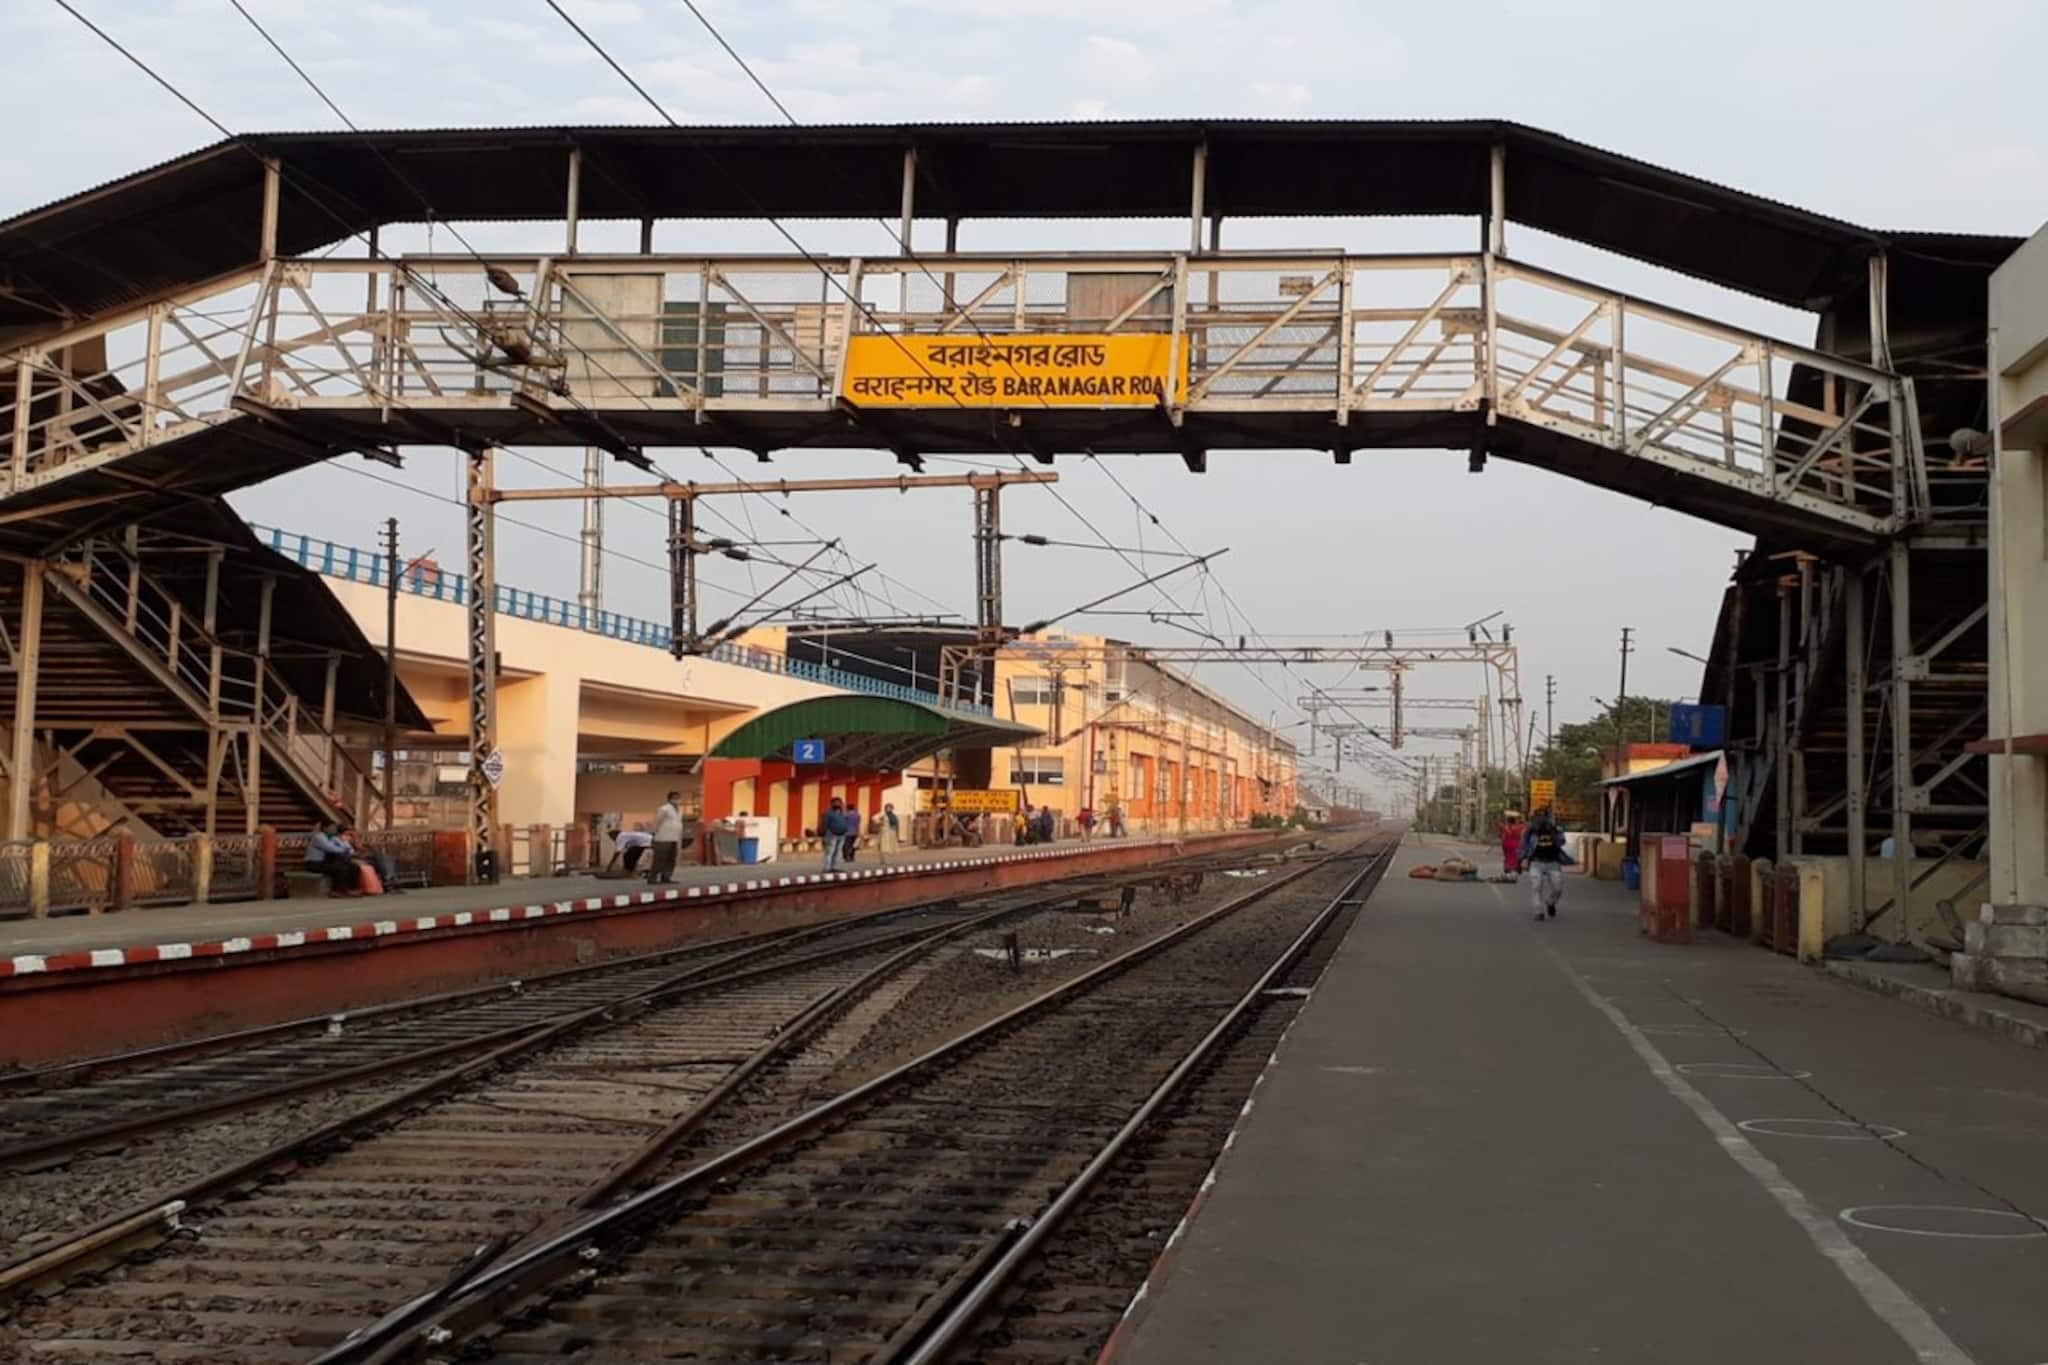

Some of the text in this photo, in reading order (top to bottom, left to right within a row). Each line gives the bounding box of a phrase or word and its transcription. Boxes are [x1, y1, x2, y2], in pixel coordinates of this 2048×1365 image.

[959, 371, 997, 396] रोड
[1003, 376, 1126, 396] BARANAGAR
[802, 743, 815, 760] 2
